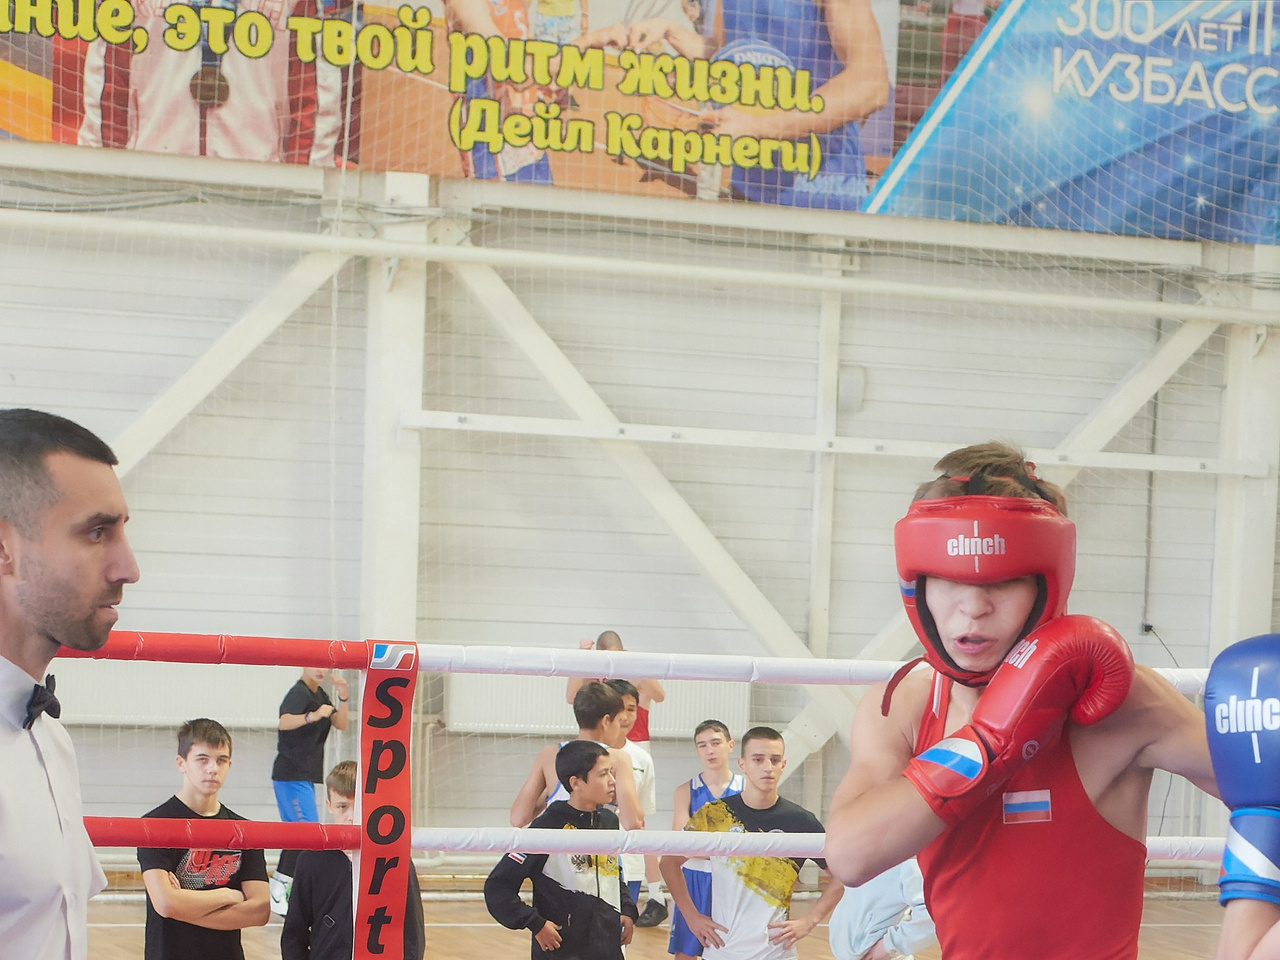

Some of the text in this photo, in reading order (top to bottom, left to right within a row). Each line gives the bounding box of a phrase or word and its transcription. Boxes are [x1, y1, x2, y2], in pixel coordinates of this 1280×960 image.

[0, 0, 825, 113] ние, это твой ритм жизни.
[1173, 20, 1242, 52] ЛЕТ
[1052, 46, 1279, 114] КУЗБАСС
[449, 97, 822, 182] (Дейл Карнеги)
[947, 533, 1006, 556] clinch
